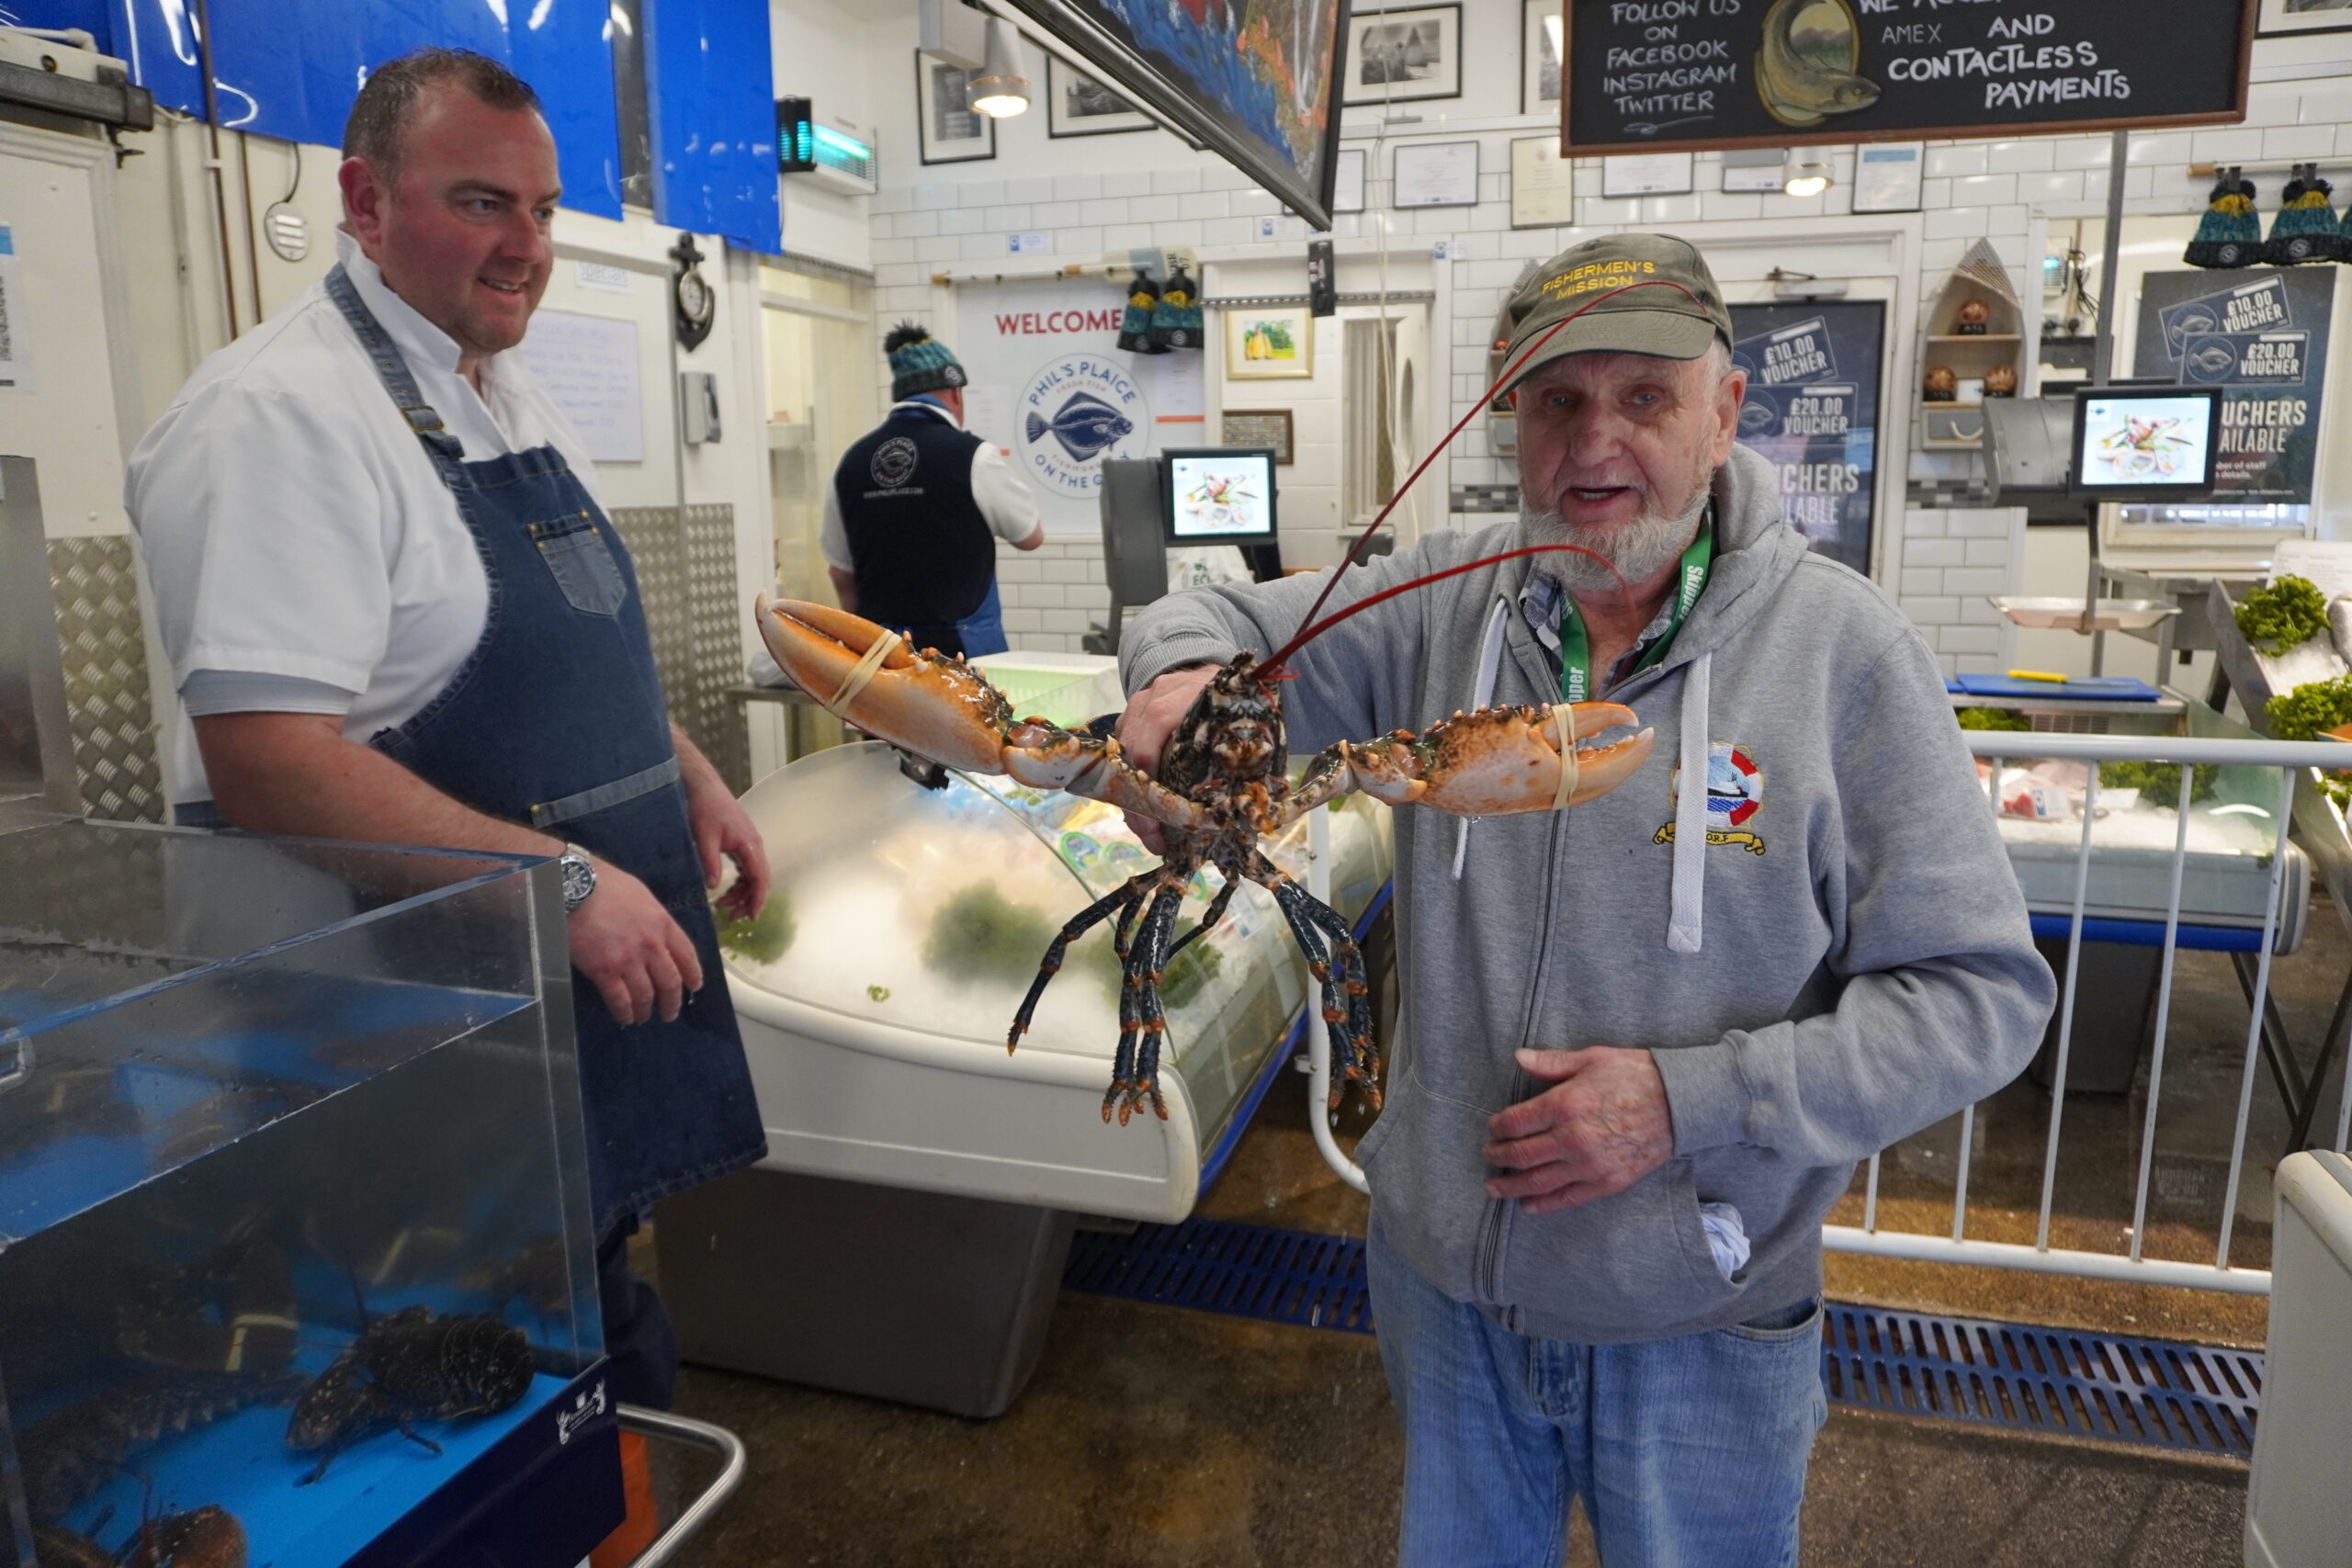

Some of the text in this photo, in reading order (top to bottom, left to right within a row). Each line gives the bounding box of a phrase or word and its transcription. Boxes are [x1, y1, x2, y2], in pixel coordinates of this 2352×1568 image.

[1611, 0, 1741, 24] FOLLOW US
[1645, 25, 1678, 40] ON
[1882, 14, 2055, 44] AMEX AND
[1607, 39, 1729, 70] FACEBOOK
[1888, 41, 2098, 81] CONTACTLESS
[1603, 63, 1737, 94] INSTAGRAM
[1985, 68, 2131, 108] PAYMENTS
[1614, 90, 1714, 114] TWITTER
[1541, 260, 1657, 294] FISHERMEN'S
[1555, 276, 1633, 300] MISSION
[2222, 303, 2283, 333] VOUCHER
[2227, 290, 2273, 317] £10.00
[995, 309, 1123, 335] WELCOME
[1765, 334, 1815, 366] £10.00
[2247, 343, 2295, 359] £20.00
[1760, 351, 1827, 384] VOUCHER
[2241, 358, 2300, 376] VOUCHER
[1029, 363, 1074, 406] PHIL'S
[1080, 361, 1136, 403] PLAICE
[1790, 397, 1843, 415] £20.00
[1784, 415, 1849, 434] VOUCHER
[1035, 454, 1057, 477] ON
[1058, 471, 1088, 488] THE
[1568, 667, 1585, 703] pper
